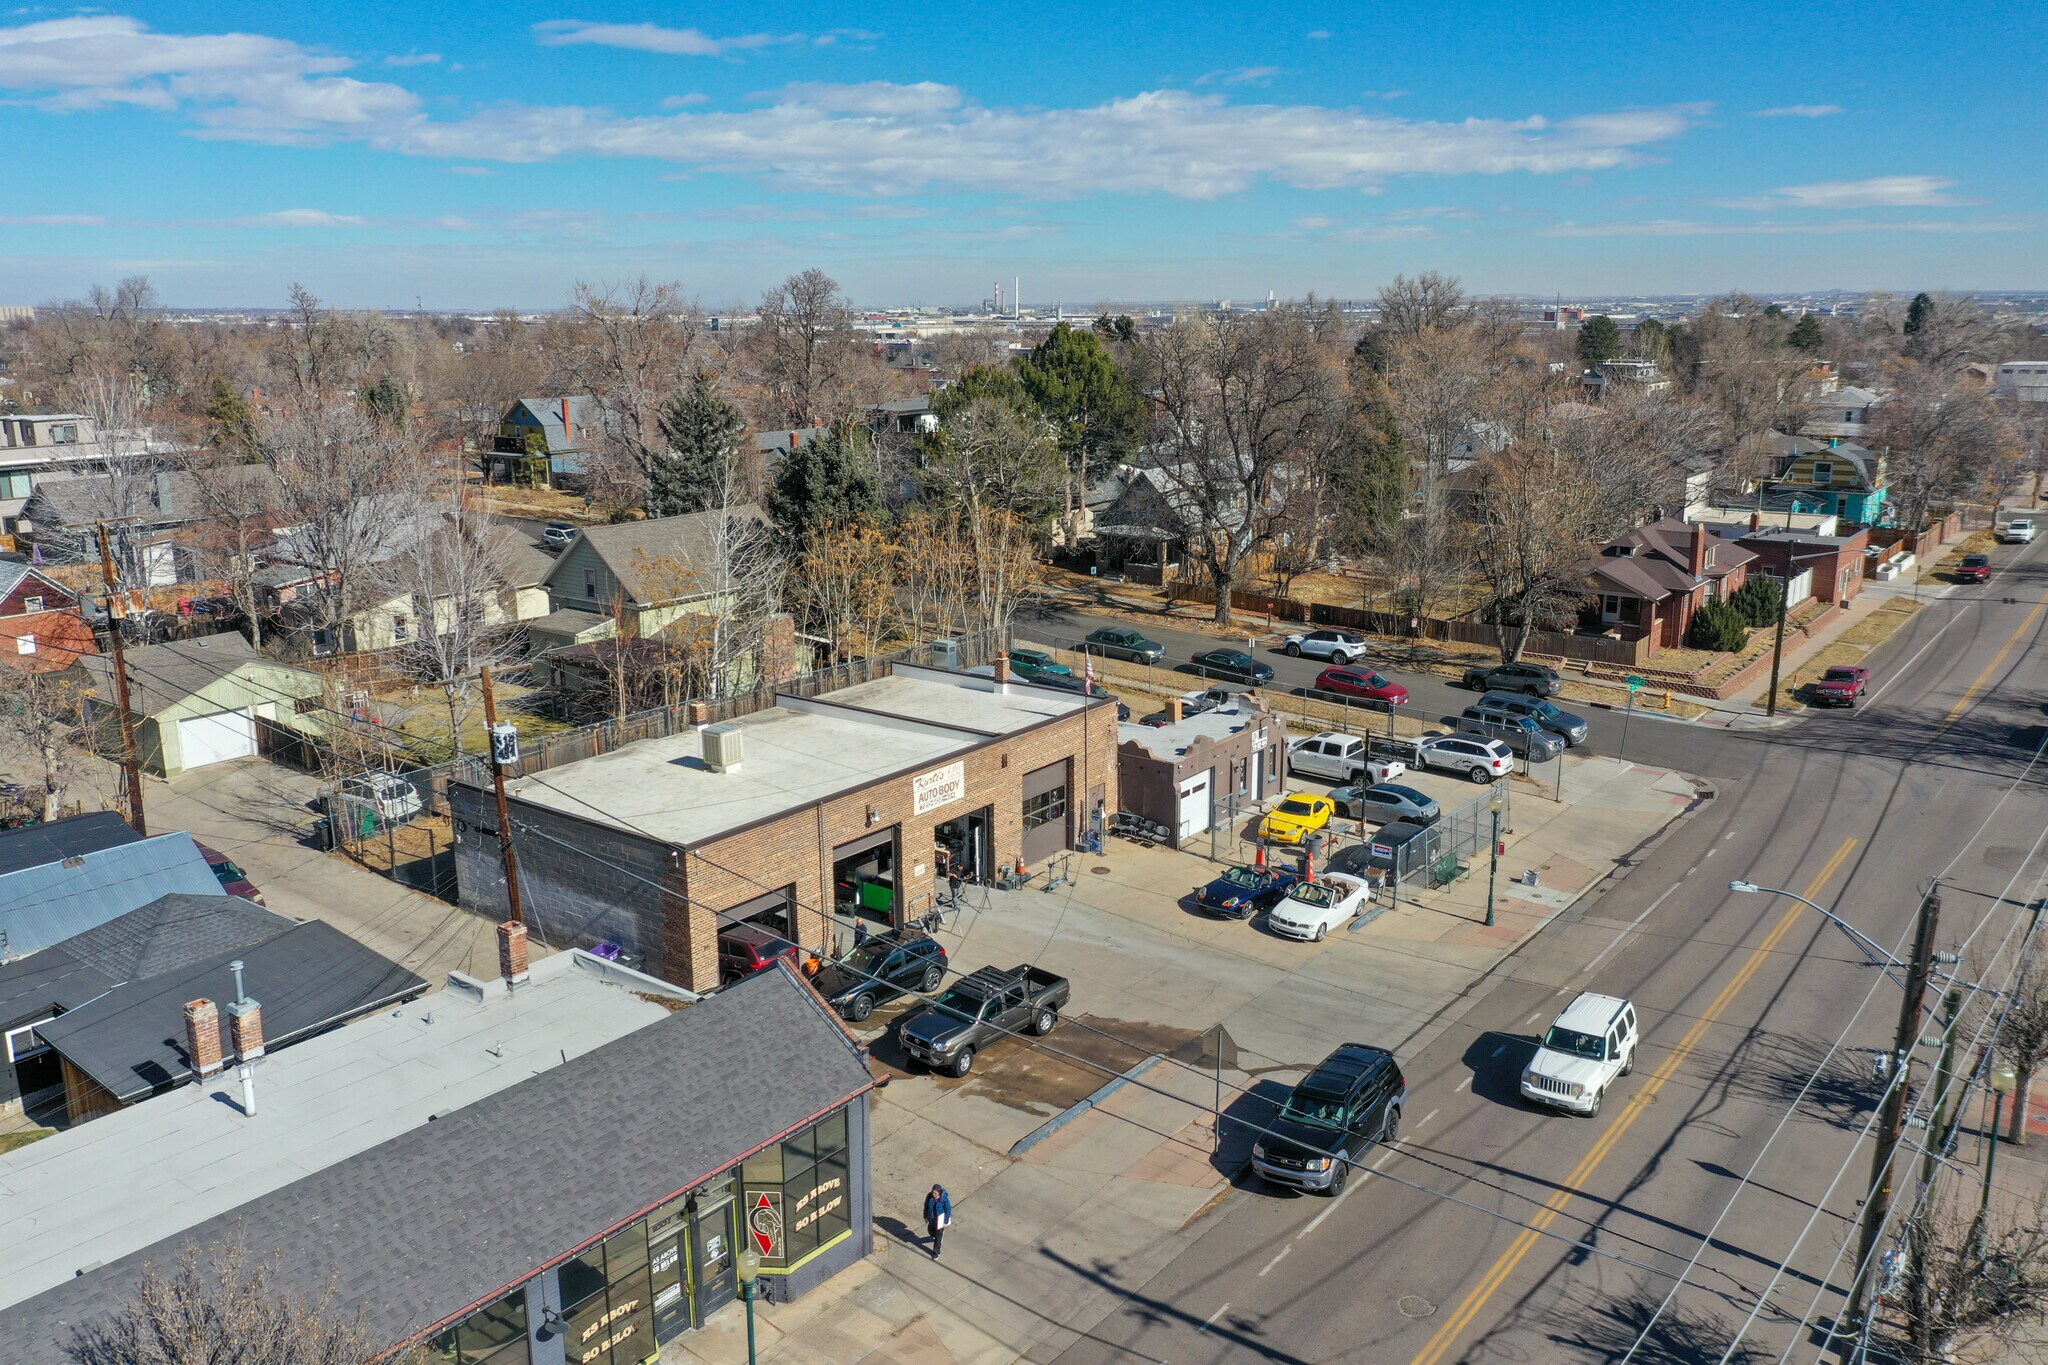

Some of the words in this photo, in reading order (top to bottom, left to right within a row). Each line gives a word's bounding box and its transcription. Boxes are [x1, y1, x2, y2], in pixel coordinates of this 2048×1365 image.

[919, 787, 938, 804] AUTO
[938, 779, 960, 796] BODY
[795, 1194, 809, 1214] AS
[810, 1177, 841, 1201] ABOVE
[795, 1216, 809, 1233] SO
[810, 1195, 842, 1224] BELOW
[652, 1256, 660, 1266] AS
[660, 1245, 678, 1260] ABOVE
[581, 1321, 599, 1344] AS
[600, 1299, 639, 1328] ABOVE
[582, 1346, 600, 1365] SO
